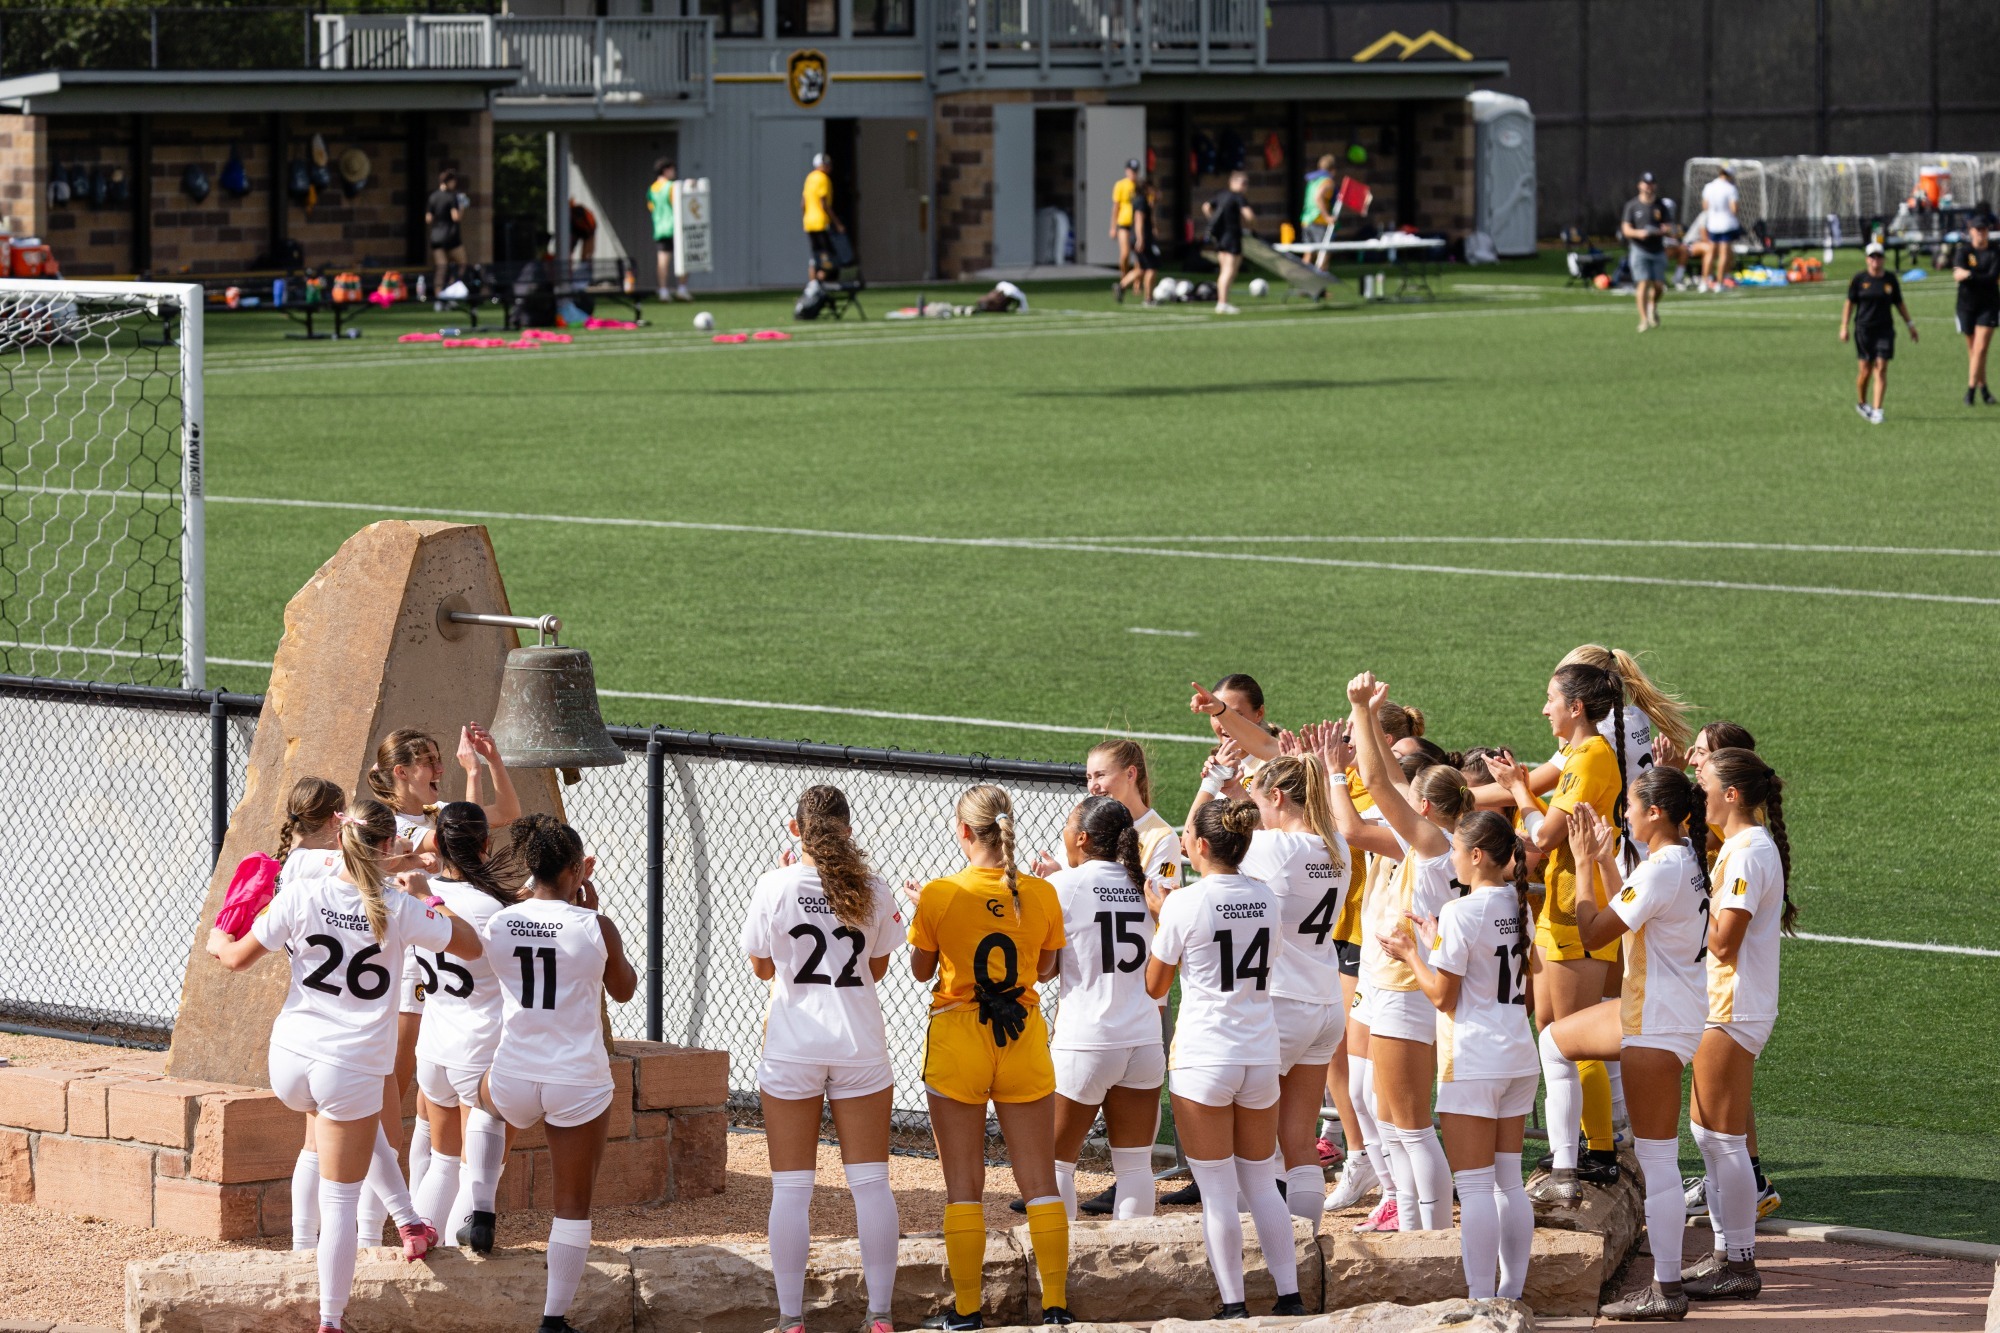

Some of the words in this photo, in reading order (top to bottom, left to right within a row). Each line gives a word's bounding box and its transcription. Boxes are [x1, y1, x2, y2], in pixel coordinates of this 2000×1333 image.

[1309, 871, 1342, 879] COLLEGE
[798, 897, 830, 906] COLO
[1100, 895, 1141, 903] COLLEGE
[804, 905, 835, 914] COLLE
[1216, 902, 1267, 912] COLORADO
[321, 908, 369, 923] COLORAD
[1223, 910, 1264, 919] COLLEGE
[1298, 887, 1338, 945] 4
[326, 916, 370, 932] COLLEGE
[507, 920, 563, 930] COLORADO
[1494, 917, 1520, 927] COLORA
[511, 928, 557, 938] COLLEGE
[1499, 926, 1519, 935] COLLE
[1094, 911, 1146, 973] 15
[788, 923, 865, 987] 22
[1213, 927, 1270, 992] 14
[302, 934, 390, 1000] 26
[973, 932, 1018, 993] 0
[512, 946, 557, 1010] 11
